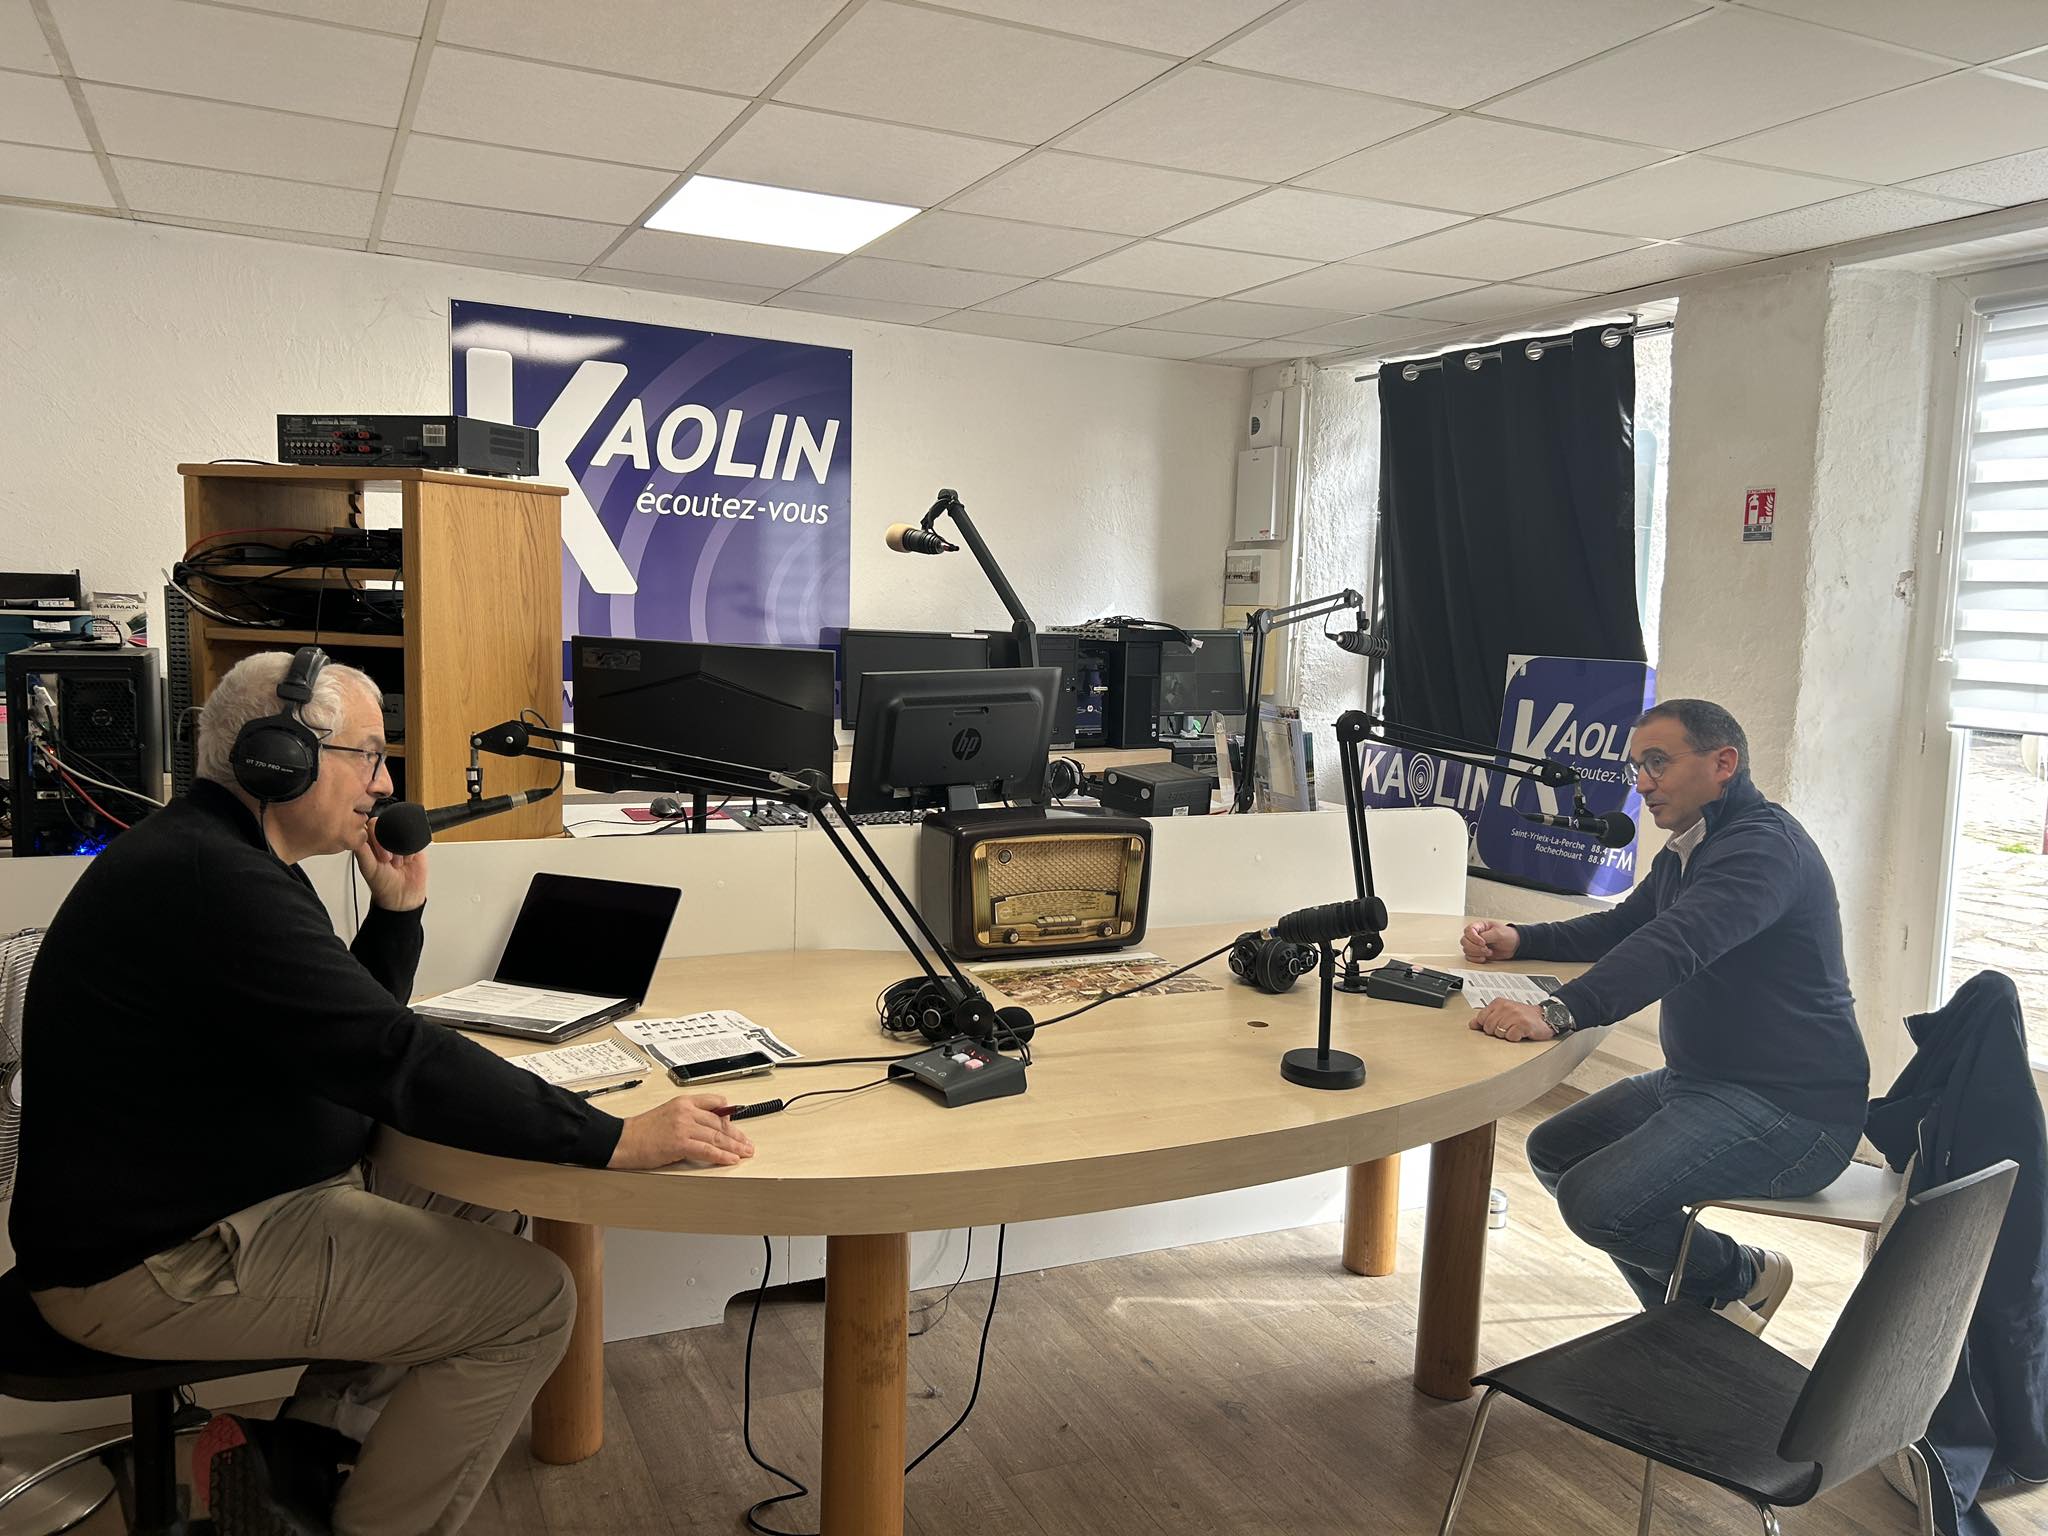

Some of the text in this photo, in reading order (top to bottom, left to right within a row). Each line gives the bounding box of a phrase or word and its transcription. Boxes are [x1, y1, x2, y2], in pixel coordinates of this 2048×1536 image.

[466, 347, 840, 595] KAOLIN
[635, 483, 830, 526] écoutez-vous
[954, 728, 981, 761] hp
[1500, 699, 1638, 815] KAOLI
[1511, 827, 1586, 851] Saint-Yrieix-La-Perche
[1535, 843, 1605, 866] Rochechouart 88.9
[1606, 848, 1633, 872] FM
